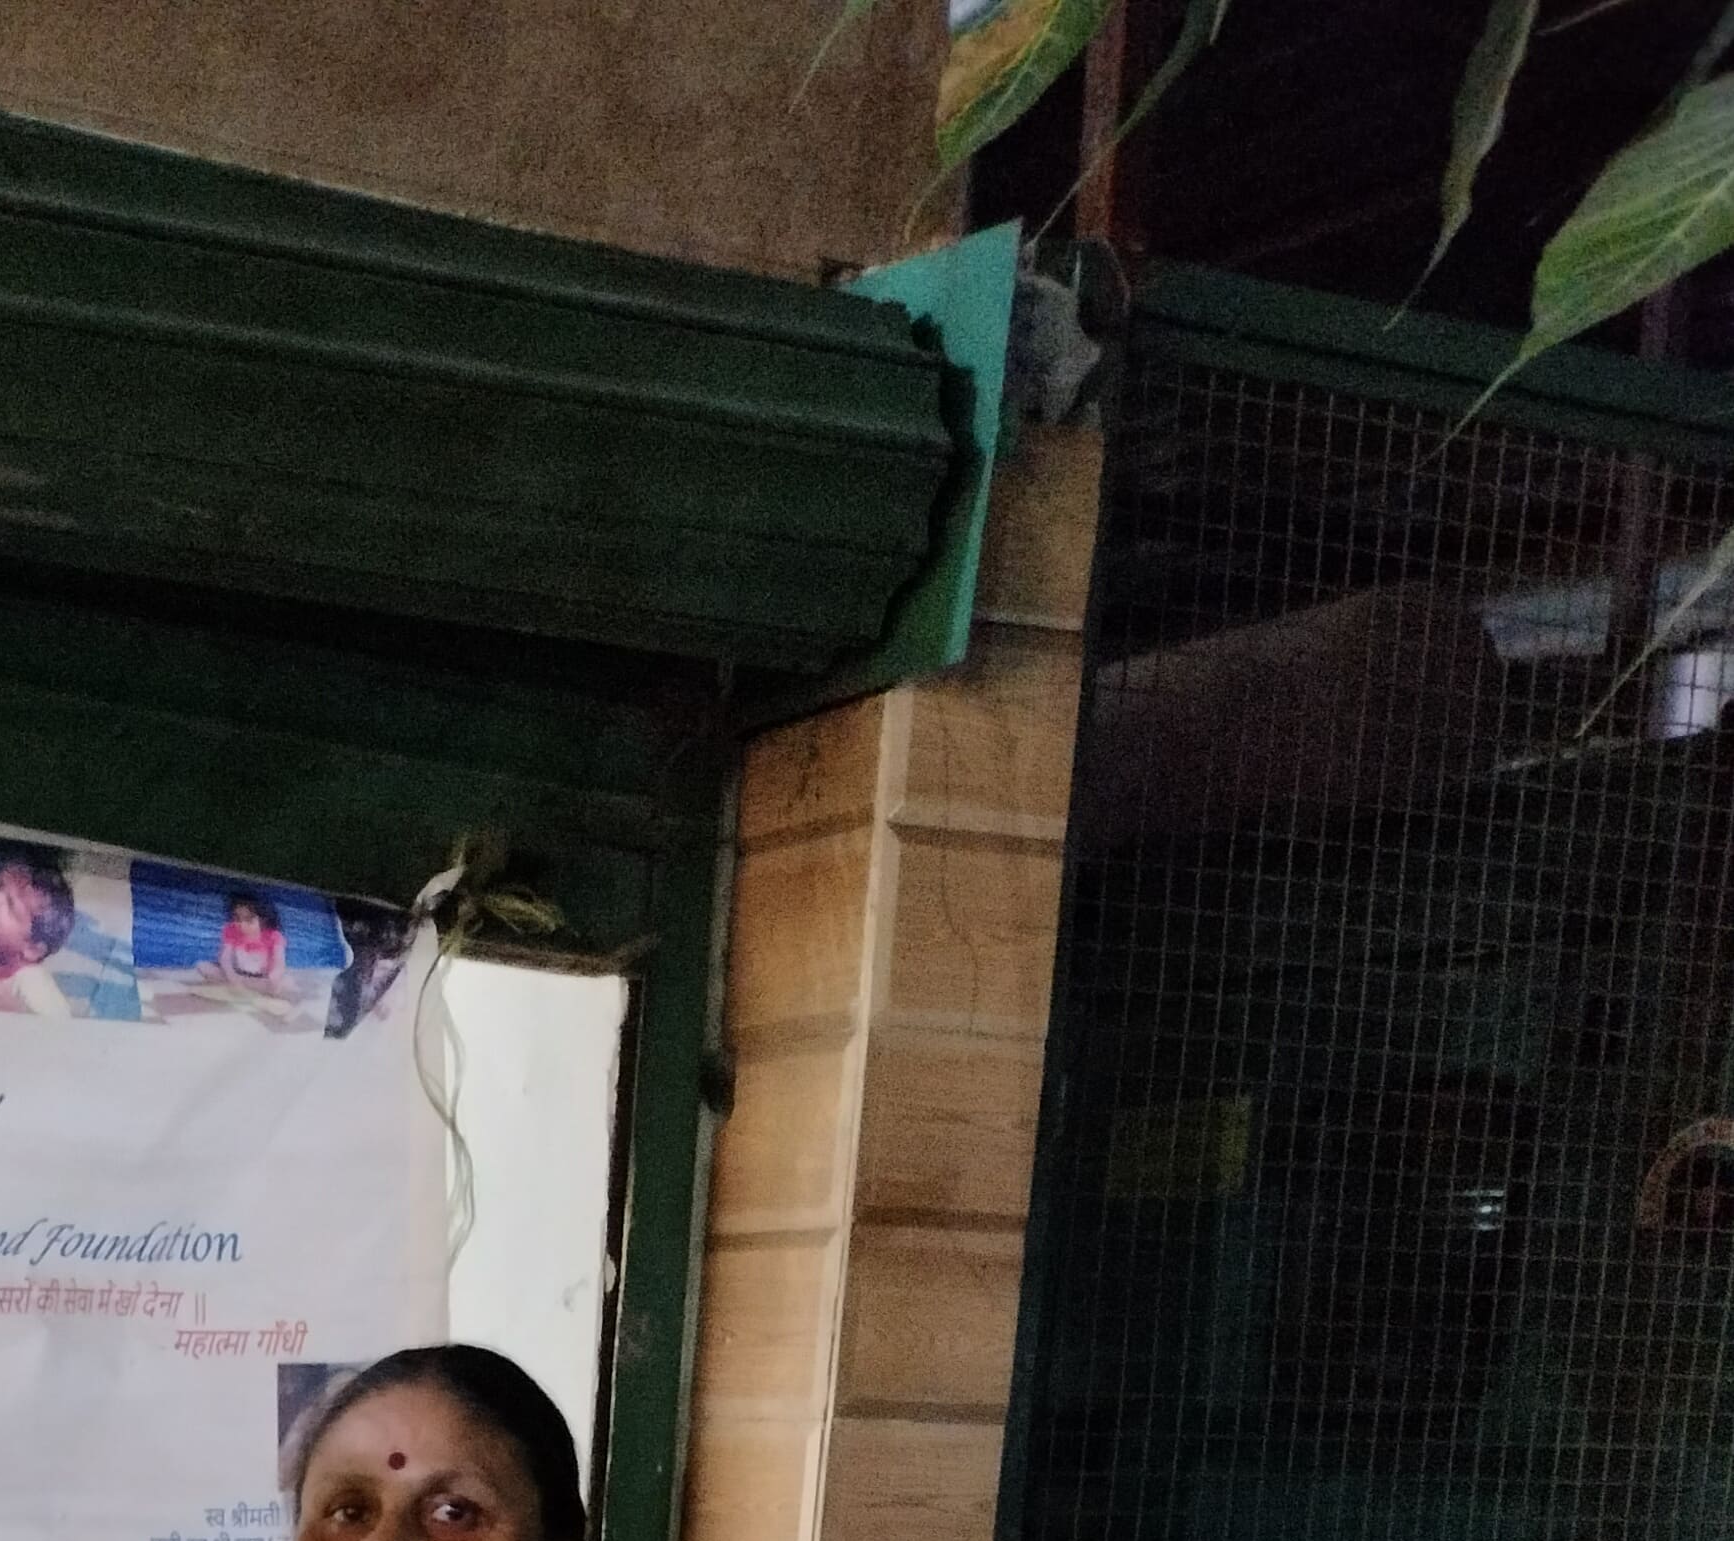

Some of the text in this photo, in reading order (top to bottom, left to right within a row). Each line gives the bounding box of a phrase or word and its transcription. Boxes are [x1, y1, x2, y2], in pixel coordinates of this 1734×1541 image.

[30, 1220, 242, 1267] Foundation
[36, 1278, 61, 1316] की
[63, 1278, 95, 1317] सेवा
[143, 1281, 184, 1319] देना
[174, 1329, 250, 1360] महात्मा
